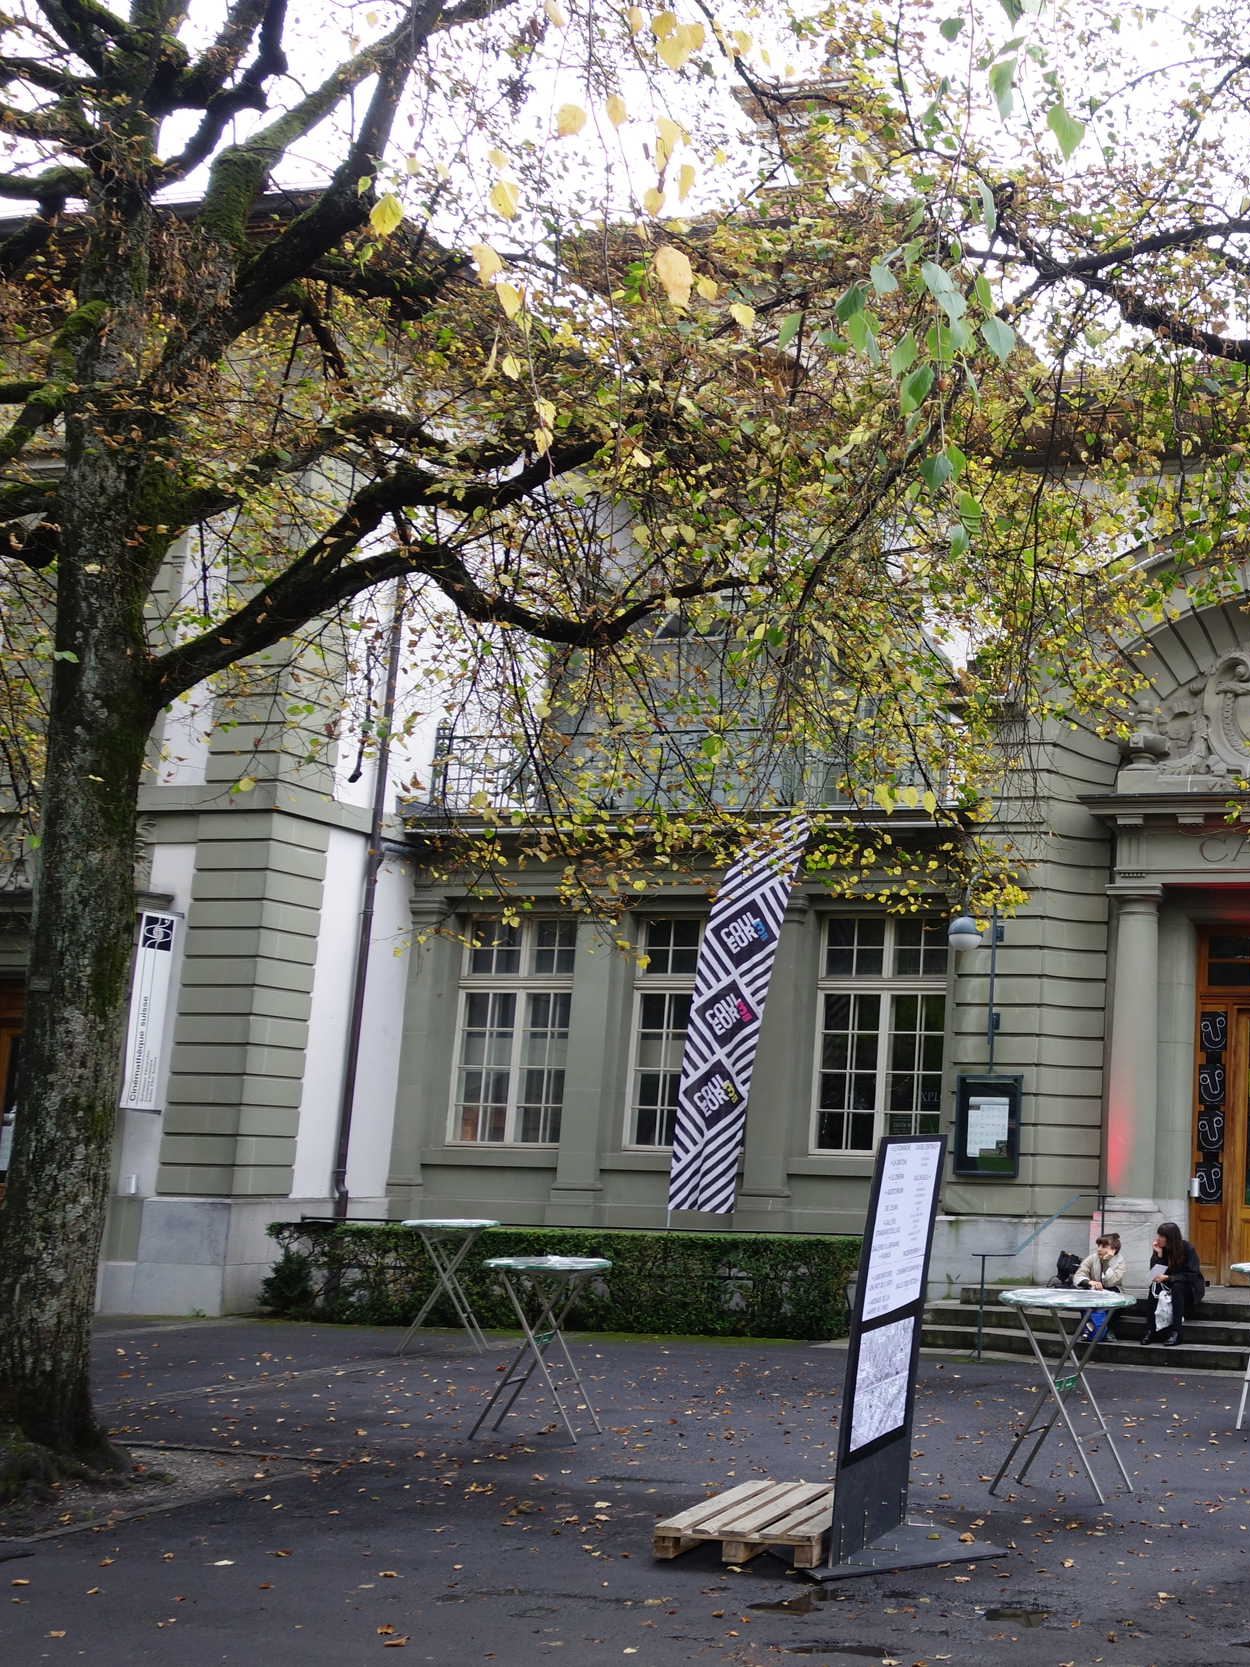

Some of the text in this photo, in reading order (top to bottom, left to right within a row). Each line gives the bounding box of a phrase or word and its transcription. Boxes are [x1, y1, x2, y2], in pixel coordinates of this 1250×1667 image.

[720, 912, 760, 942] COUL
[705, 993, 741, 1024] COUL
[130, 996, 148, 1101] Cinémathèque suisse
[694, 1074, 730, 1107] COUL
